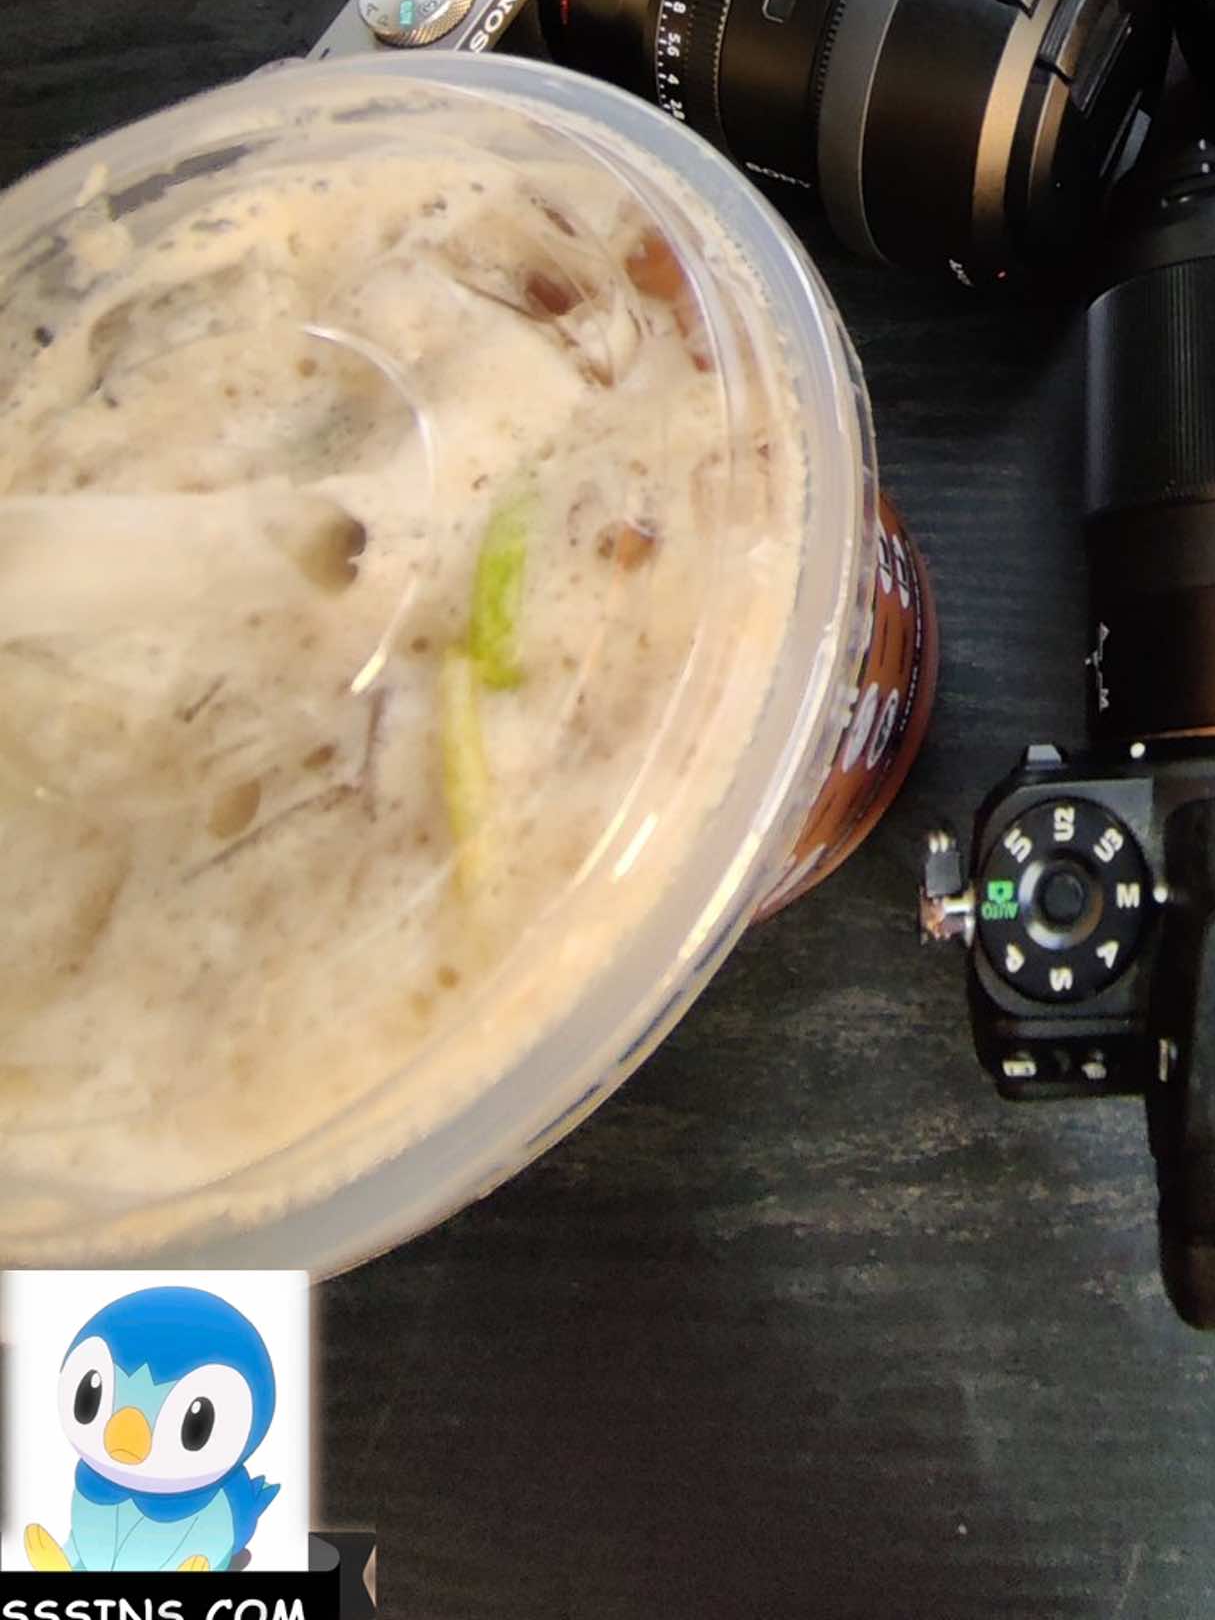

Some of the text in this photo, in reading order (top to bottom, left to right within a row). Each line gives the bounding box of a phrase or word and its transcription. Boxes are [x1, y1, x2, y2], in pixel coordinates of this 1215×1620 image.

[672, 1, 687, 14] 8
[666, 32, 682, 58] 5.6
[667, 73, 680, 85] 4
[1053, 806, 1075, 842] U2
[1093, 827, 1124, 863] U3
[1116, 883, 1141, 909] M
[980, 901, 1020, 921] AUTO
[1005, 942, 1025, 973] P
[1096, 940, 1120, 969] A
[1049, 966, 1073, 992] S
